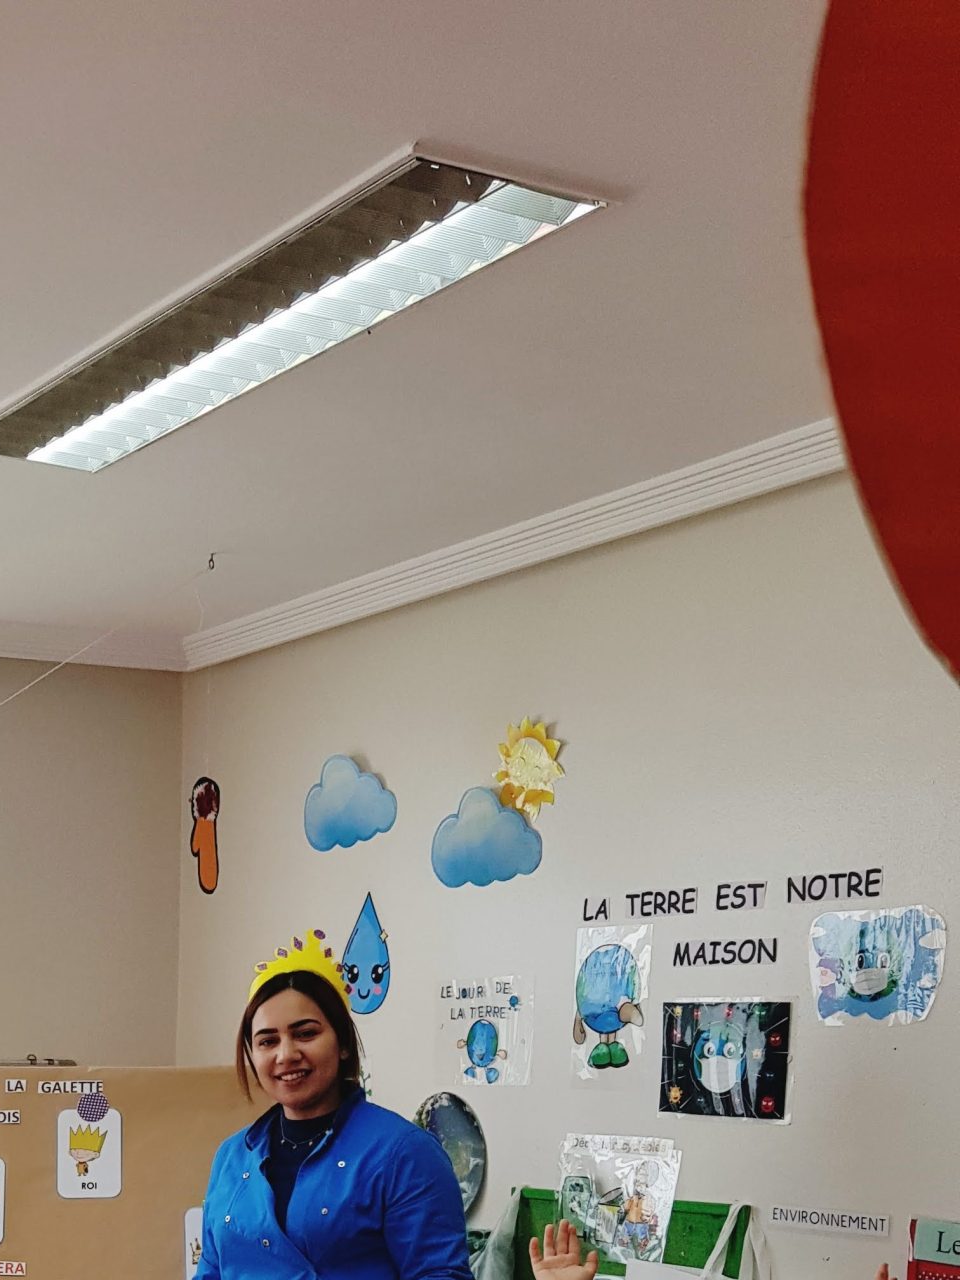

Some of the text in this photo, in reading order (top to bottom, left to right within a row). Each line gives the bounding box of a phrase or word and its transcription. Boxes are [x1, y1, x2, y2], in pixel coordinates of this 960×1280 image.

[582, 868, 882, 922] LA TERRE EST NOTRE
[673, 938, 778, 967] MAISON
[440, 981, 511, 1000] LE JOUR DE
[450, 1006, 507, 1020] LA TERRE
[7, 1080, 24, 1092] LA
[41, 1081, 103, 1094] GALETTE
[81, 1182, 97, 1190] ROI
[772, 1207, 886, 1232] ENVIRONNEMENT
